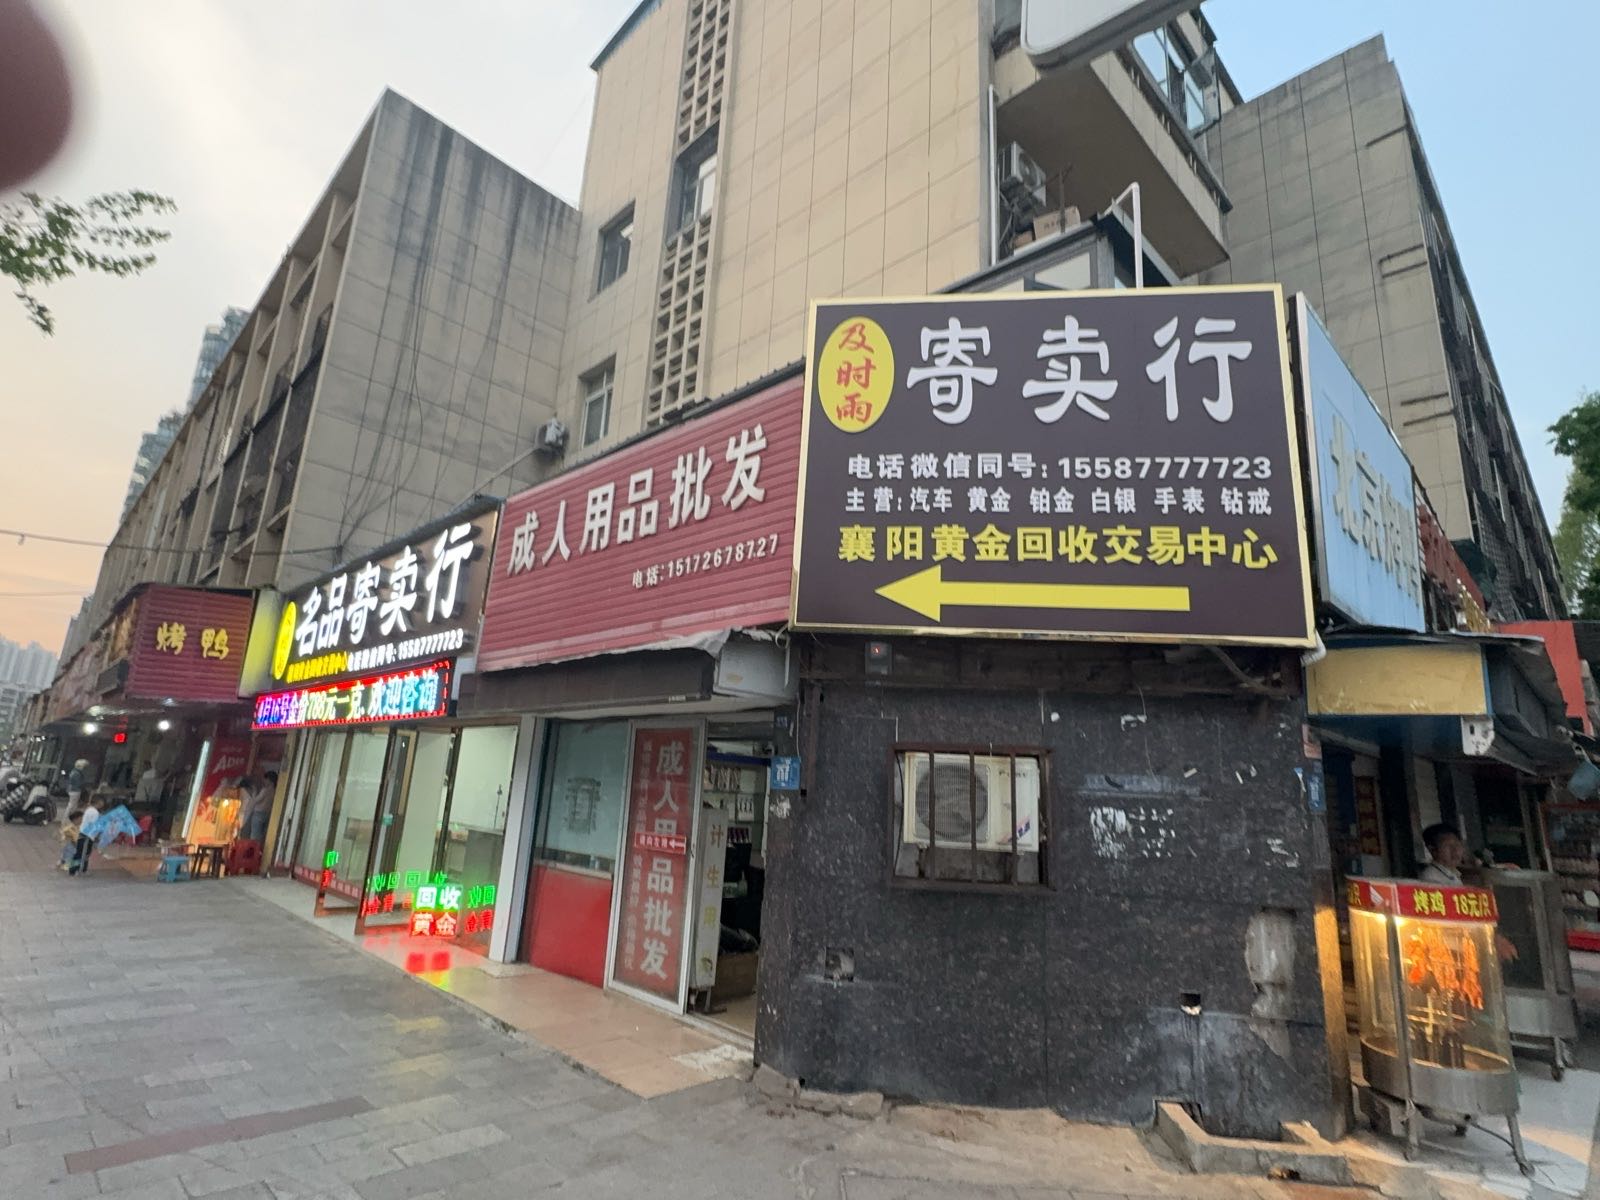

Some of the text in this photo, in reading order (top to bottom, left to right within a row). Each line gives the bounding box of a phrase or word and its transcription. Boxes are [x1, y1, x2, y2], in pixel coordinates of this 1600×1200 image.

[835, 322, 876, 424] 及时雨
[906, 314, 1253, 425] 寄卖行
[506, 423, 769, 576] 成人用品批发
[967, 487, 1012, 514] 黄金
[1029, 487, 1075, 514] 铂金
[1091, 487, 1137, 515] 白银
[1154, 487, 1206, 515] 手表
[1221, 487, 1272, 516] 钻戒
[838, 524, 1279, 569] 襄阳黄金回收交易中心
[296, 522, 475, 657] 名品寄卖行
[156, 621, 229, 660] 烤鸭
[416, 886, 461, 910] 回收
[411, 911, 457, 936] 黄金
